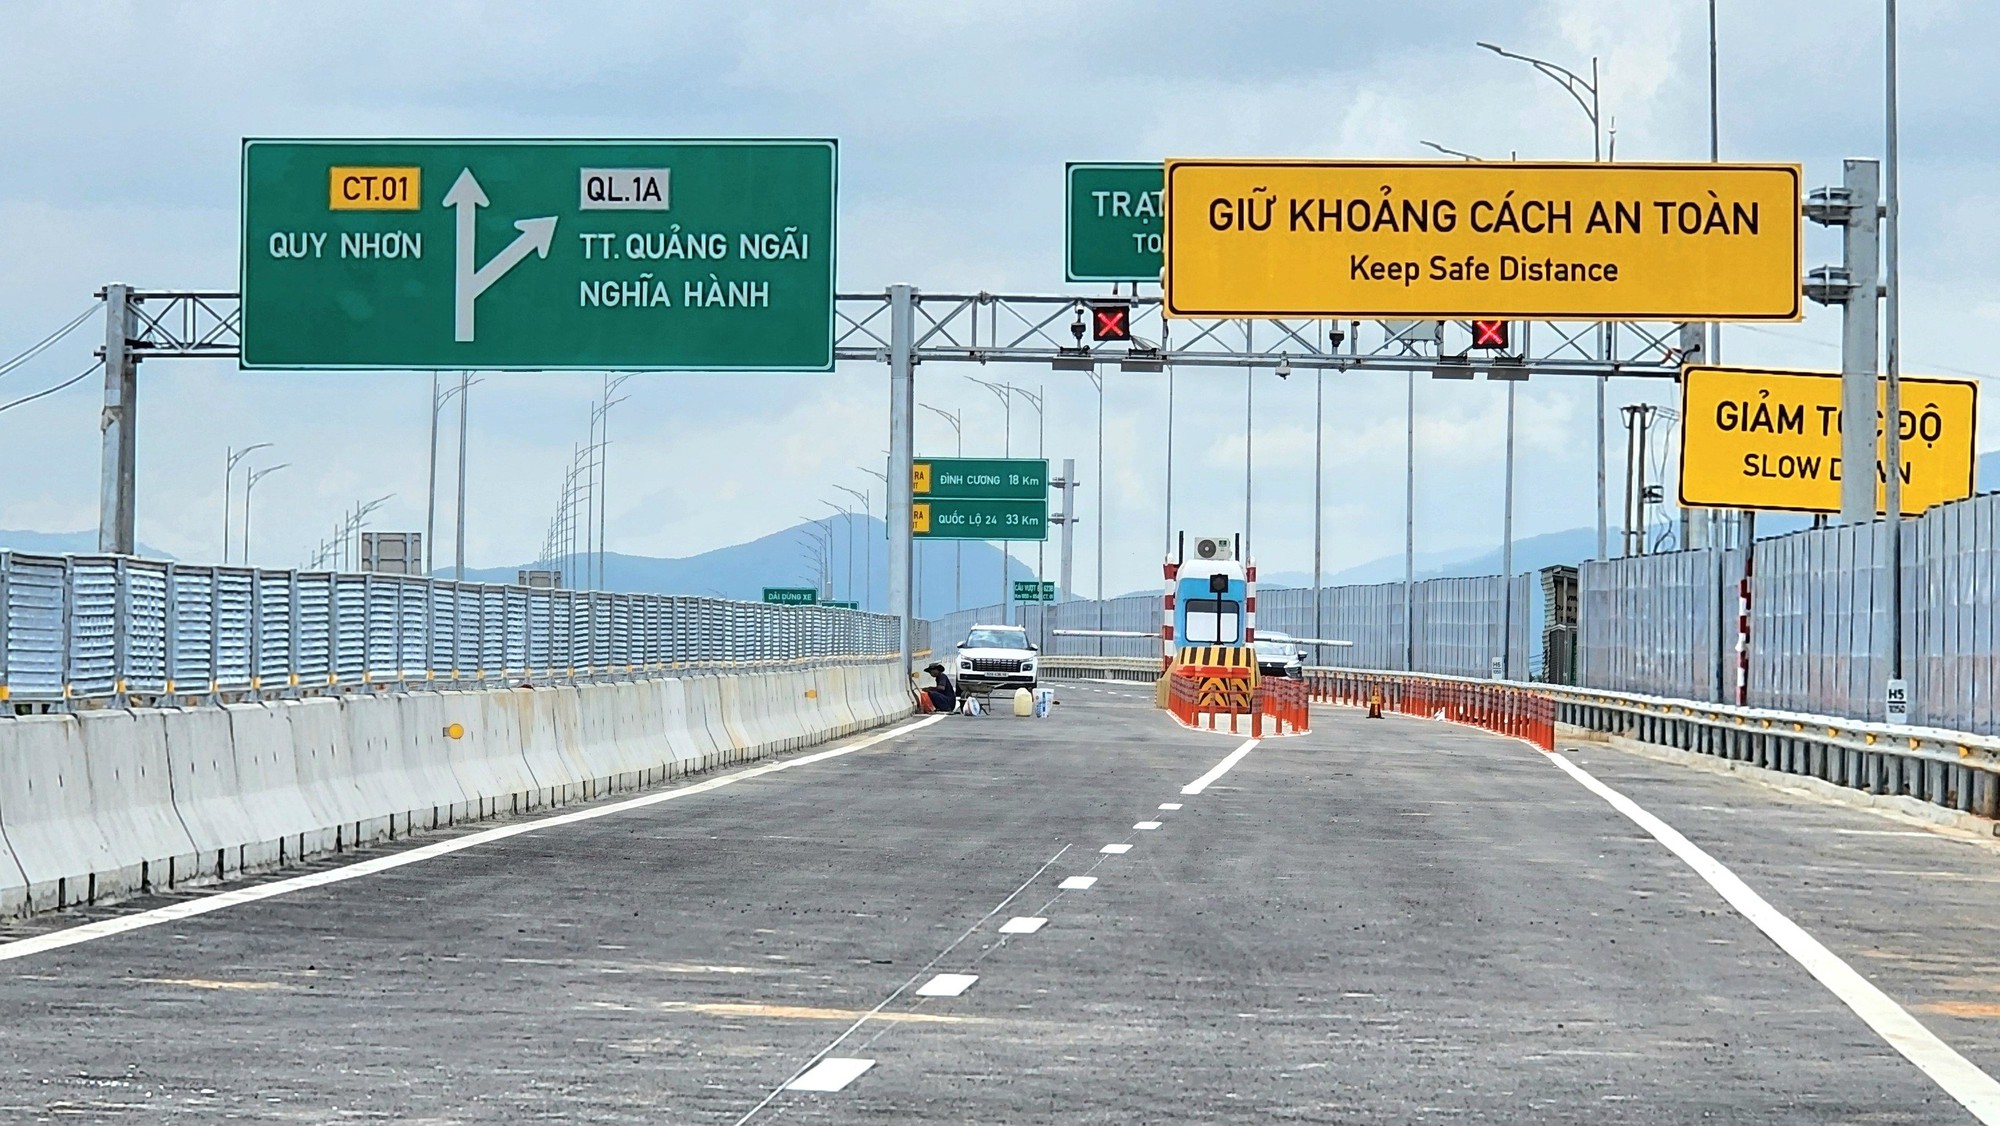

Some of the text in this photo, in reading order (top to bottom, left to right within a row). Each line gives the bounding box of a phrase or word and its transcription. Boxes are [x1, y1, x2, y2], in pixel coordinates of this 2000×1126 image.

[344, 176, 408, 202] CT.01
[587, 176, 662, 203] QL.1A
[1210, 185, 1759, 235] GIỮ KHOẢNG CÁCH AN TOÀN
[269, 230, 422, 259] QUY NHƠN
[739, 226, 808, 260] NGÃI
[1350, 254, 1618, 288] Keep Safe Distance
[580, 272, 769, 308] NGHĨA HÀNH
[1716, 389, 1804, 436] GIẢM
[914, 471, 925, 481] RA
[940, 472, 1039, 486] ĐÌNH CƯƠNG 18 Km
[1743, 453, 1820, 480] SLOW
[914, 510, 924, 520] RA
[938, 509, 1039, 527] QUỐC LỘ 24 33 Km
[802, 593, 812, 601] XE
[1888, 688, 1904, 700] H5
